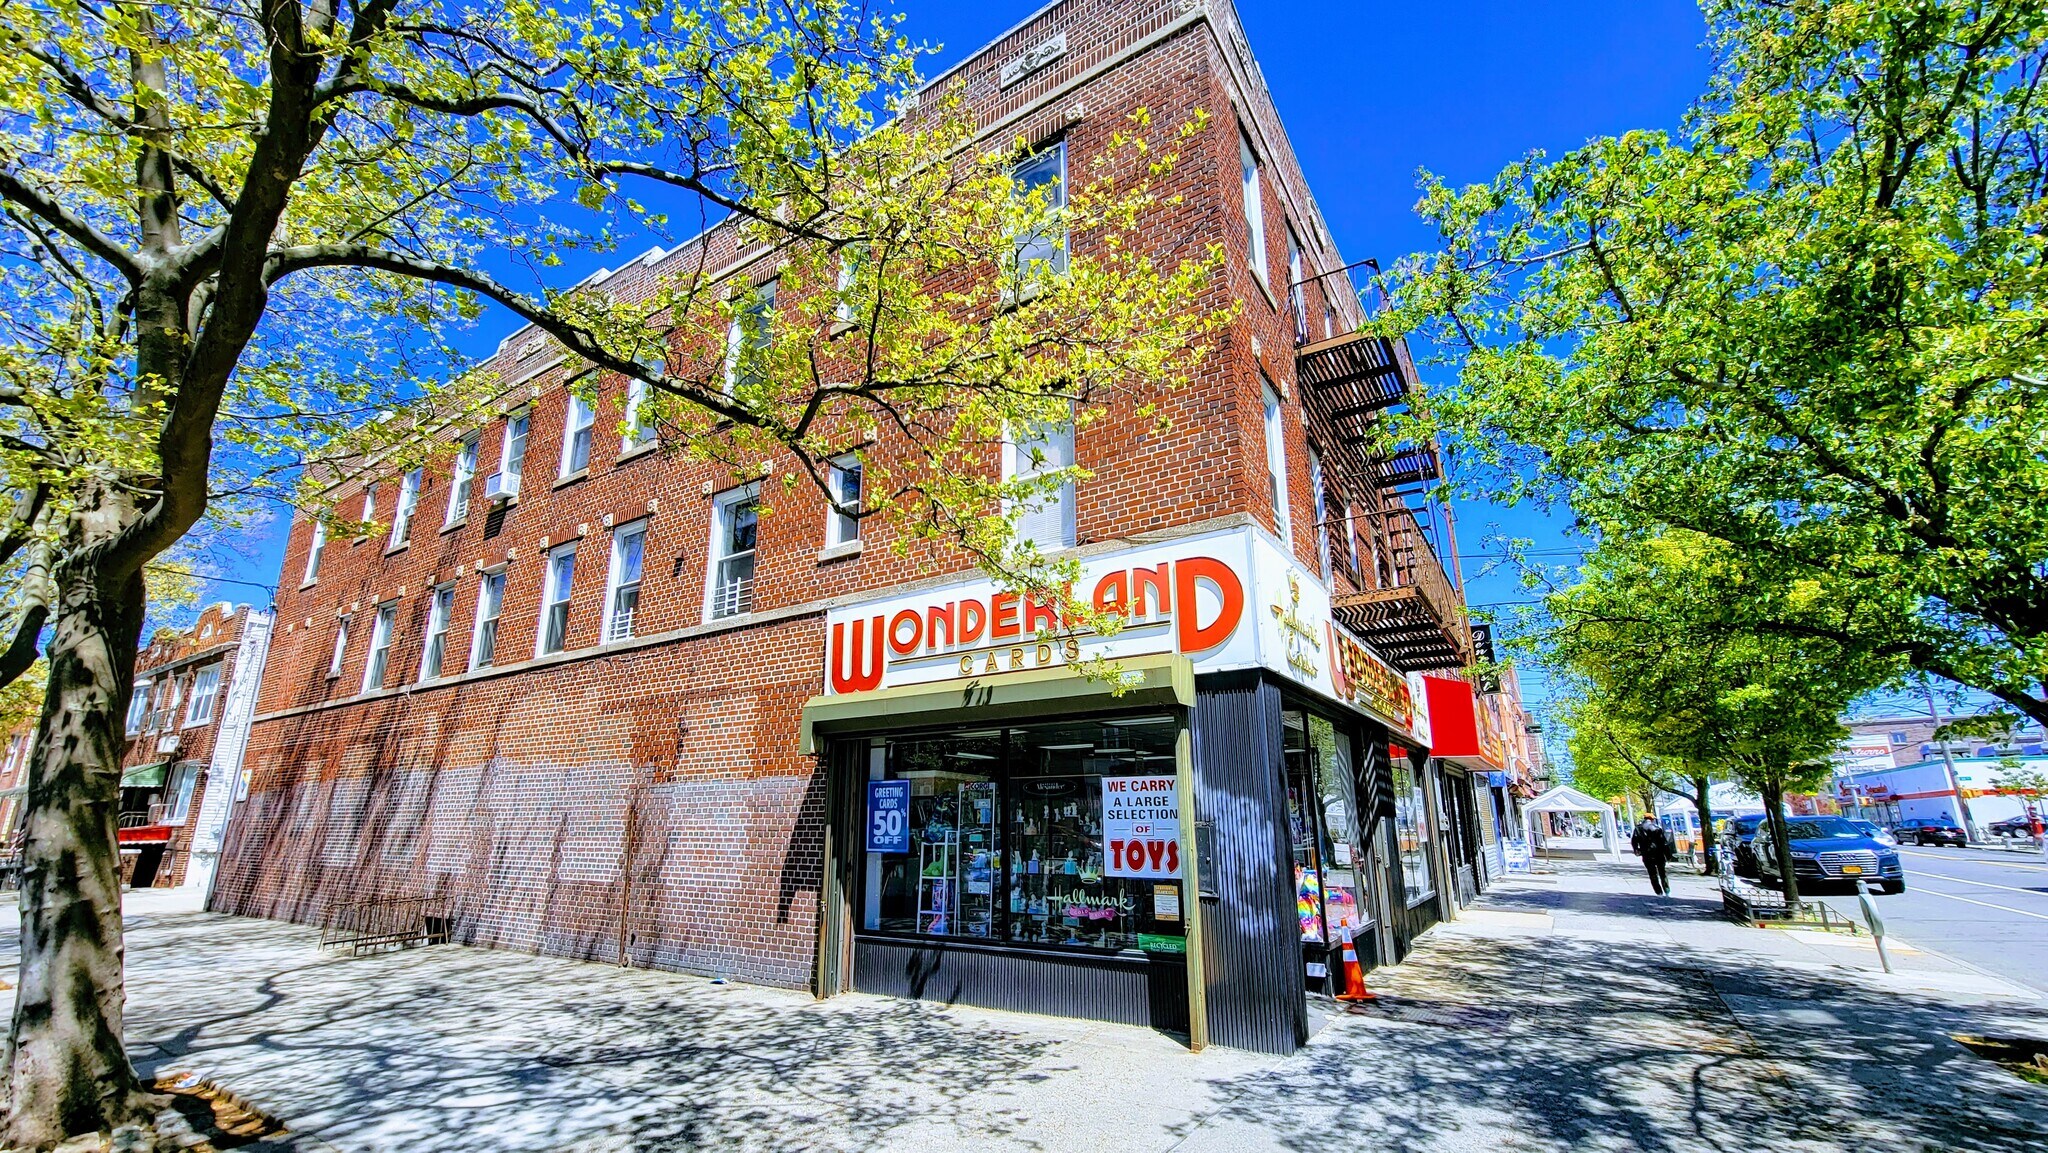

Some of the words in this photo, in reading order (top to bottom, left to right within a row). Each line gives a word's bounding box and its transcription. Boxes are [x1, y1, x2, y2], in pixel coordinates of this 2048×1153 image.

[832, 556, 1245, 694] WONDERLAND
[959, 639, 1081, 676] CARDS
[1107, 781, 1127, 792] WE
[1131, 779, 1175, 792] CARRY
[874, 787, 904, 798] GREETING
[879, 798, 898, 809] CARDS
[1113, 796, 1122, 807] A
[1127, 796, 1169, 807] LARGE
[1108, 809, 1178, 820] SELECTION
[1136, 825, 1151, 833] OF
[873, 835, 902, 845] OFF
[1109, 837, 1180, 875] TOYS
[1046, 884, 1137, 914] Hallmark
[1149, 941, 1178, 951] RECYCLED
